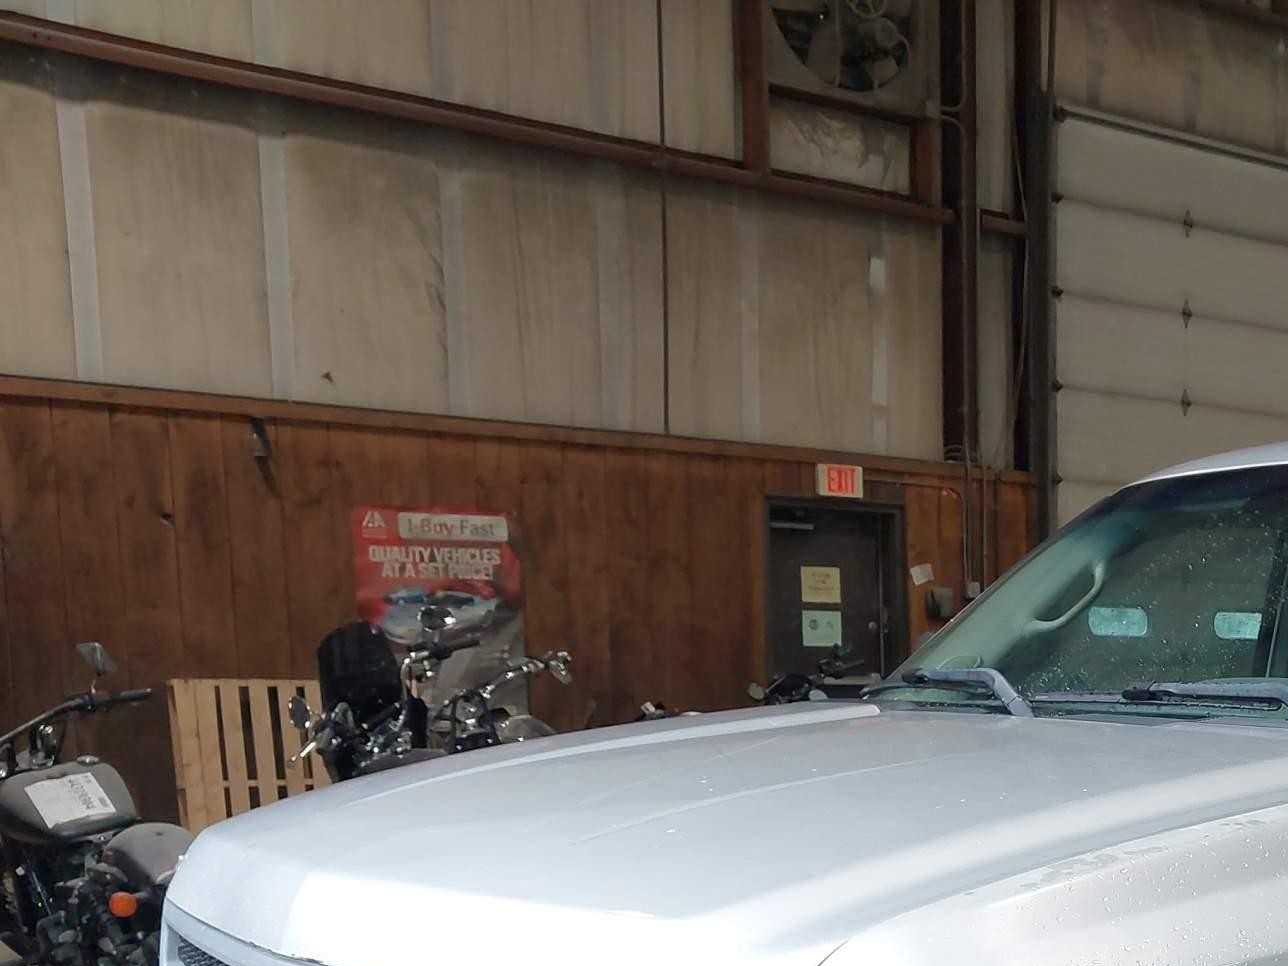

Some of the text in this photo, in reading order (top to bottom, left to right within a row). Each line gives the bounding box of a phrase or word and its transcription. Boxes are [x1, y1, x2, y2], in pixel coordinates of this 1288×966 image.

[827, 466, 856, 494] EXIT
[460, 519, 495, 537] Fast
[368, 545, 501, 566] QUALITY VEHICLES
[382, 562, 402, 578] AT
[402, 562, 416, 578] A
[418, 563, 446, 580] SET
